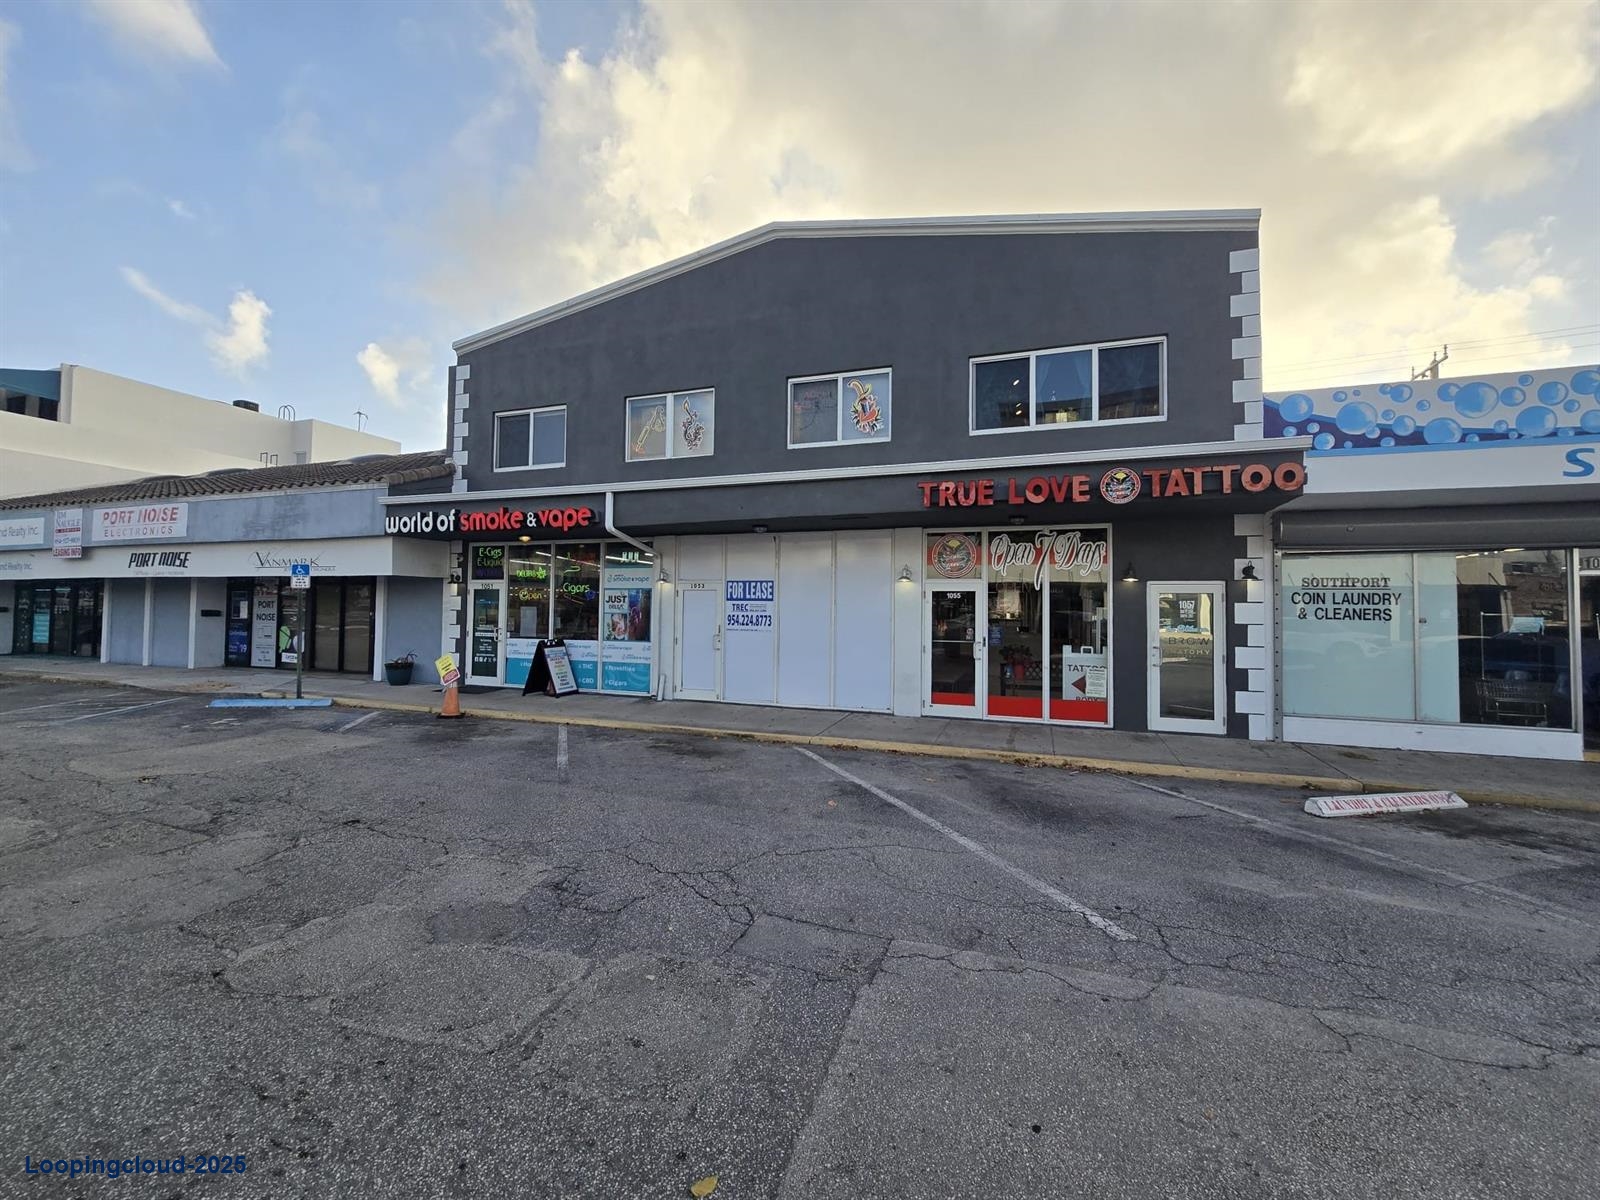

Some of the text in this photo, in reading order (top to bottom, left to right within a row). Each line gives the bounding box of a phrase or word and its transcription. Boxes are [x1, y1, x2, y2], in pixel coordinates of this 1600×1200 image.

[918, 479, 994, 507] TRUE
[1008, 474, 1091, 504] LOVE
[1142, 462, 1306, 497] TATTOO
[103, 507, 179, 525] PORT NOISE
[385, 506, 592, 533] world of smoke & vape
[104, 526, 173, 537] ELECTRONICS
[479, 547, 502, 559] E-Cigs
[128, 552, 191, 568] PORT NOISE
[991, 534, 1035, 576] Open
[1035, 531, 1057, 590] 7
[1055, 531, 1107, 576] Days
[563, 582, 590, 594] Cigars
[1302, 577, 1390, 587] SOUTHPORT
[728, 582, 772, 599] FOR LEASE
[258, 600, 275, 608] PORT
[606, 595, 627, 604] JUST
[1178, 600, 1195, 610] 1057
[1291, 592, 1402, 606] COIN LAUNDRY
[732, 604, 748, 612] TREC
[256, 613, 276, 622] NOISE
[728, 614, 772, 626] 954.224.8773
[1298, 608, 1392, 621] & CLEANERS
